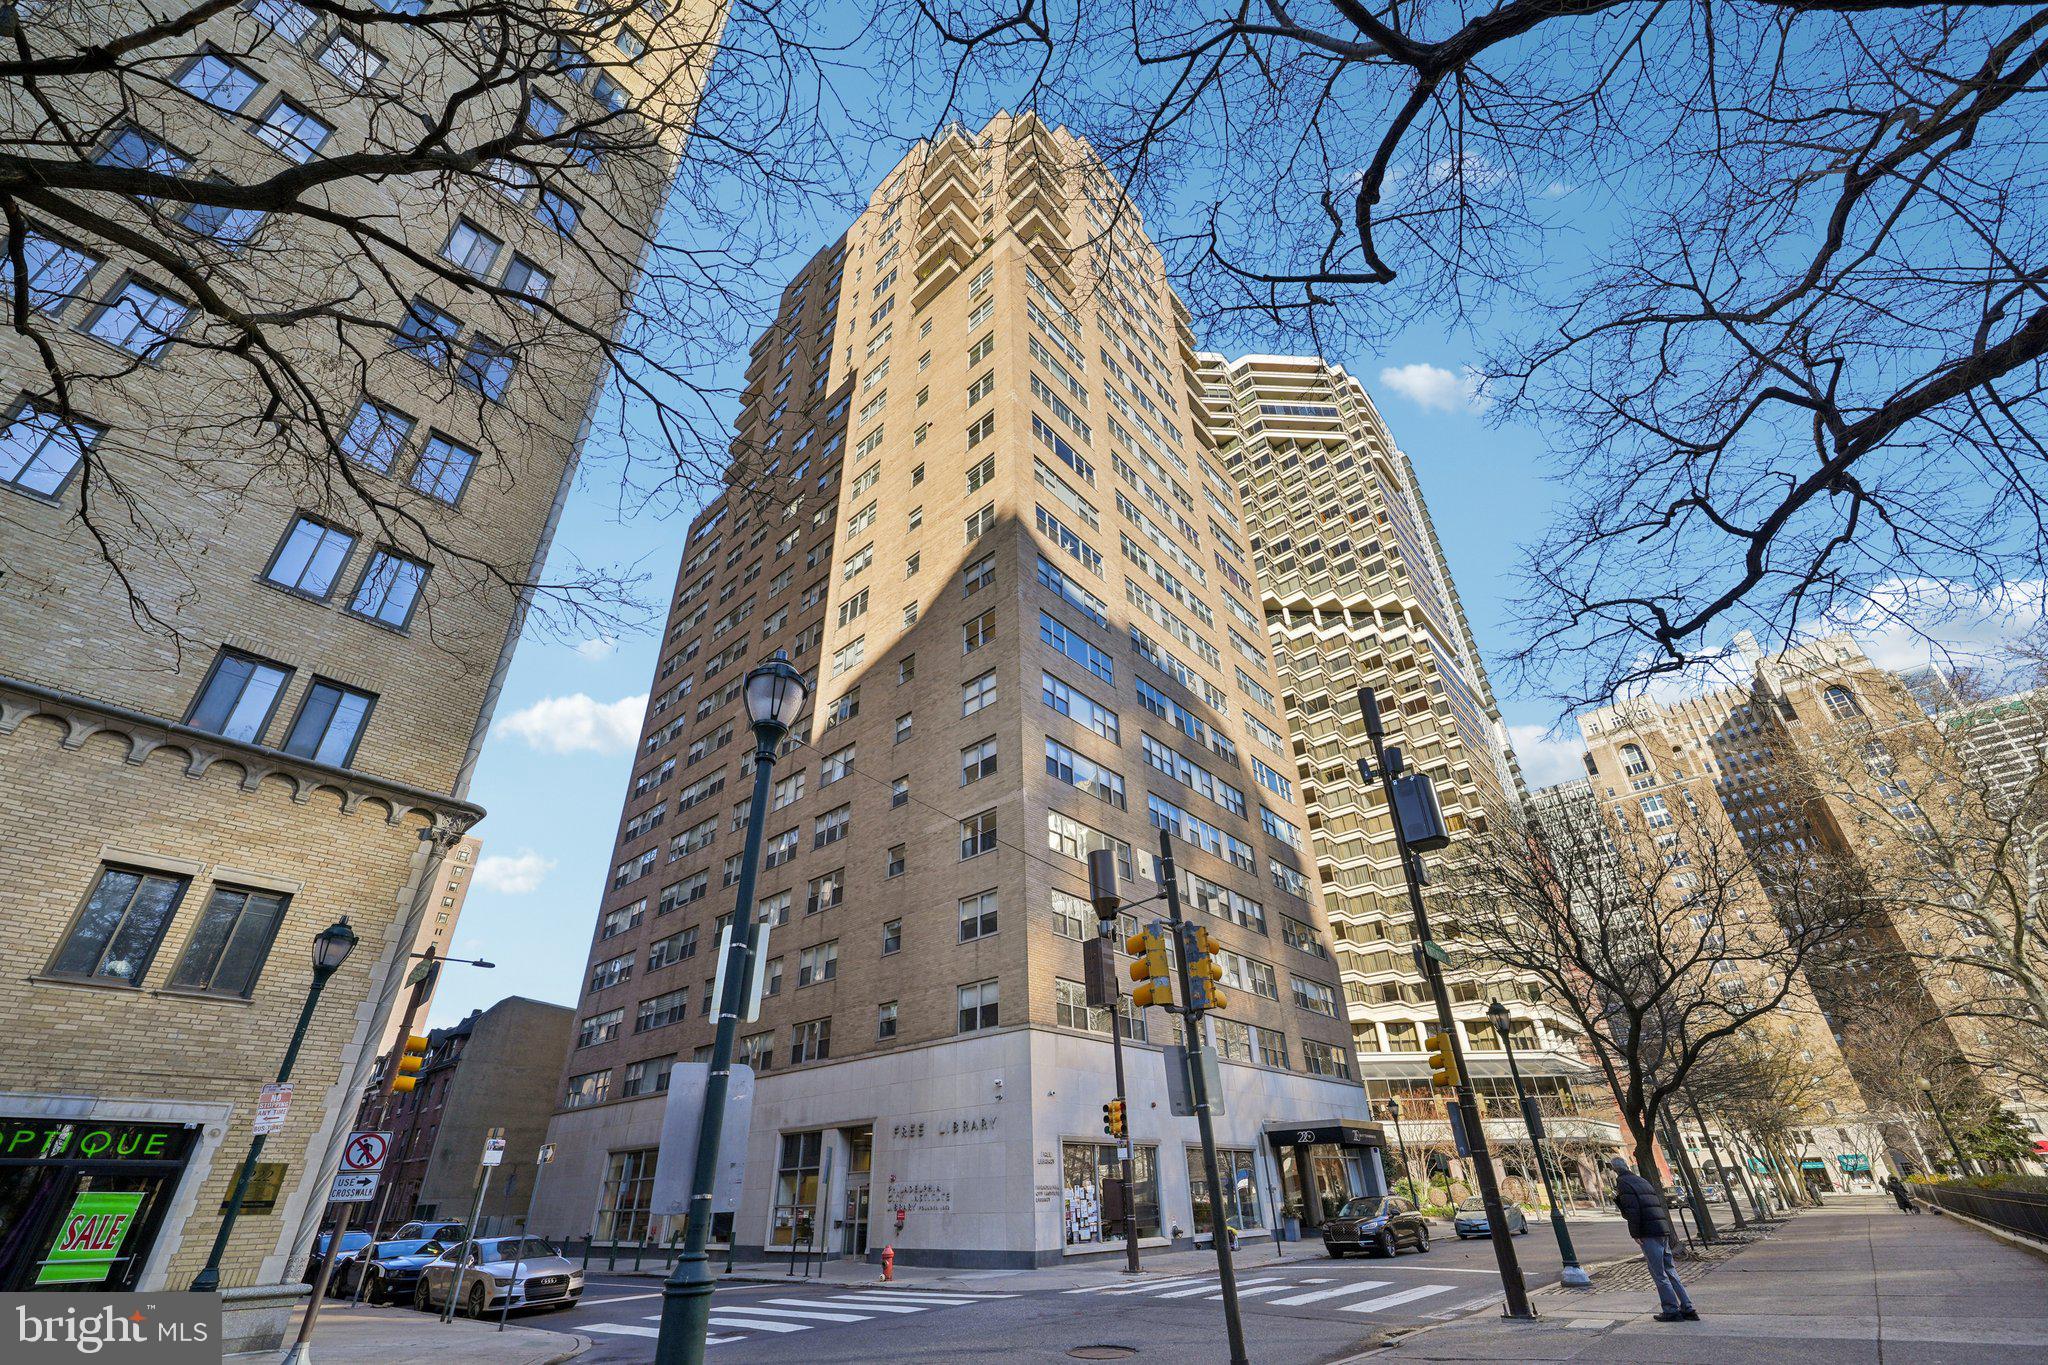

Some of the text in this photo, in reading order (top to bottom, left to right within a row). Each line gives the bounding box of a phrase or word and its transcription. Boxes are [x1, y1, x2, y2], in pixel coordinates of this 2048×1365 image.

[270, 1094, 282, 1102] NO
[258, 1101, 289, 1109] STOPPING
[893, 1116, 997, 1138] FREE LIBRARY
[1297, 1130, 1316, 1143] 220
[0, 1131, 168, 1158] PTIQUE
[337, 1178, 356, 1187] USE
[331, 1188, 374, 1197] CROSSWALK
[59, 1213, 129, 1252] SALE
